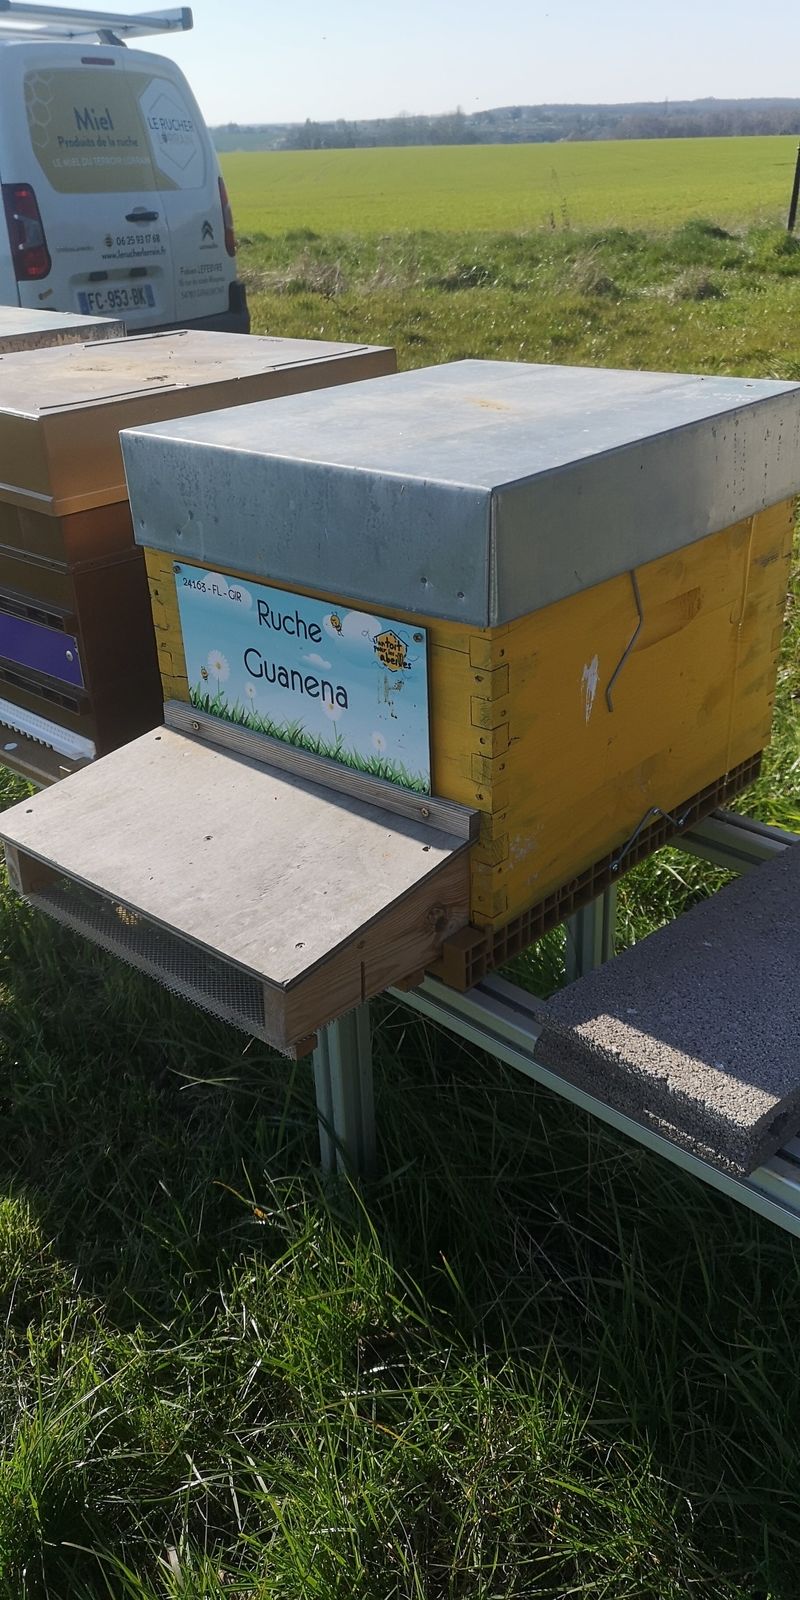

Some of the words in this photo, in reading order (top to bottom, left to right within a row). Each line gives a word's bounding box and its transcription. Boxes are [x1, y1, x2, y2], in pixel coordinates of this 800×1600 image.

[74, 107, 115, 131] Miel
[147, 117, 159, 130] LE
[160, 118, 193, 133] RUCHER
[57, 136, 96, 148] Produits
[97, 135, 108, 147] de
[109, 135, 116, 147] la
[117, 136, 138, 147] ruche
[116, 236, 126, 246] 06
[127, 235, 136, 246] 25
[136, 235, 145, 245] 93
[257, 599, 323, 643] Ruche
[385, 637, 402, 651] toit
[380, 652, 412, 669] abeilles
[243, 647, 349, 709] Guanena
